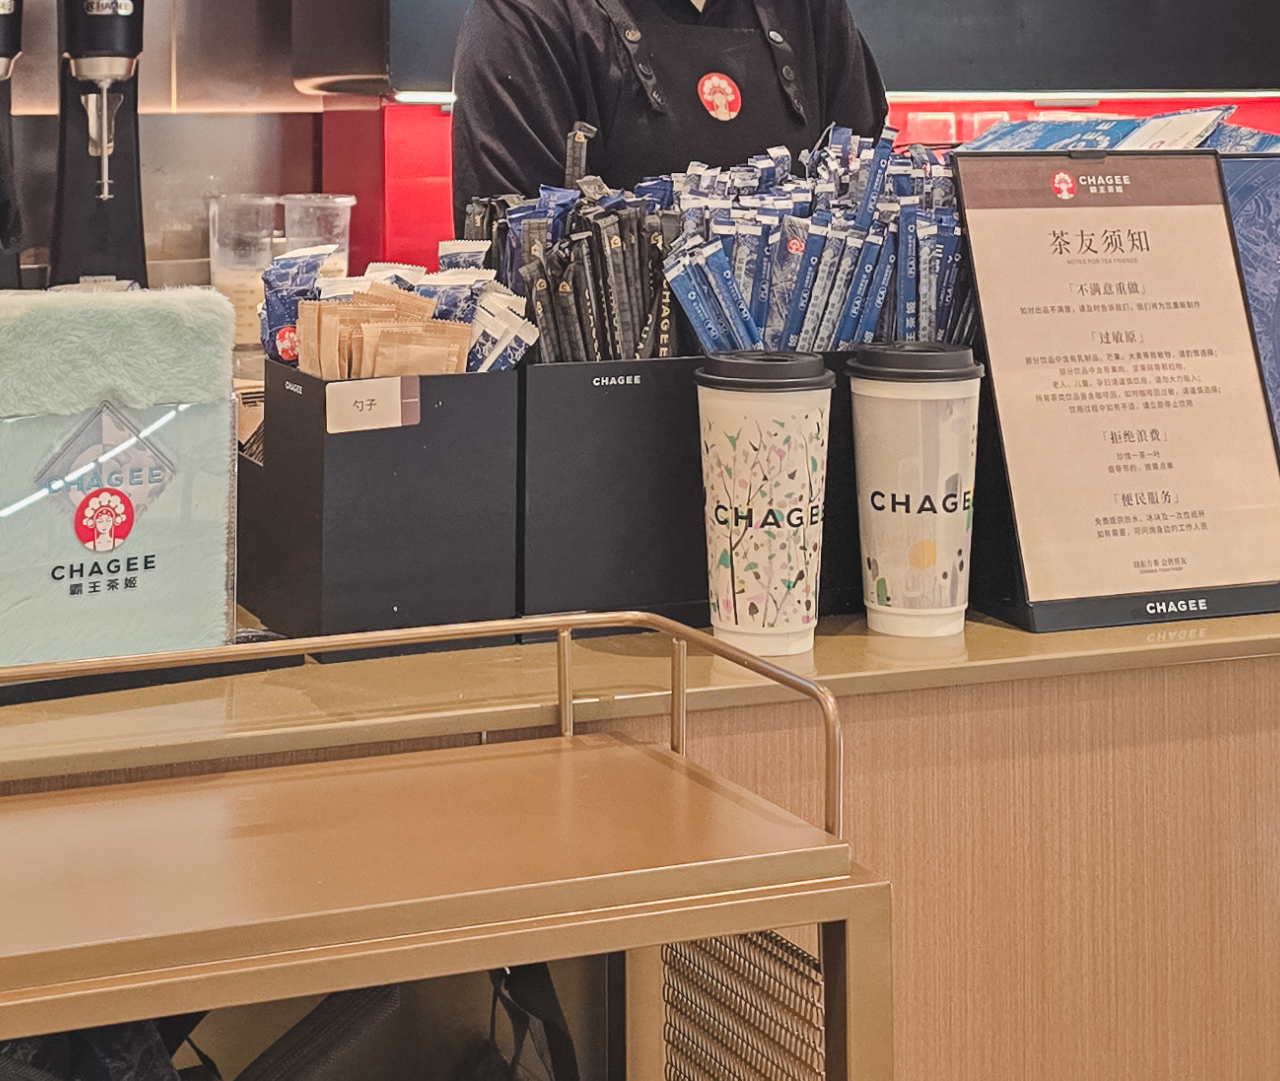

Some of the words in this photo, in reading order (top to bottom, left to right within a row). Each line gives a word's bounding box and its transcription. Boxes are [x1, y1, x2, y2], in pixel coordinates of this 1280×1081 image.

[1078, 175, 1131, 185] CHAGEE
[1047, 228, 1151, 255] 茶友须知
[592, 374, 641, 386] CHAGEE
[352, 398, 377, 413] 勺子
[714, 504, 824, 529] CHAGE
[50, 554, 157, 581] CHAGEE
[69, 576, 138, 596] 霸王茶姬
[1145, 598, 1208, 614] CHAGEE
